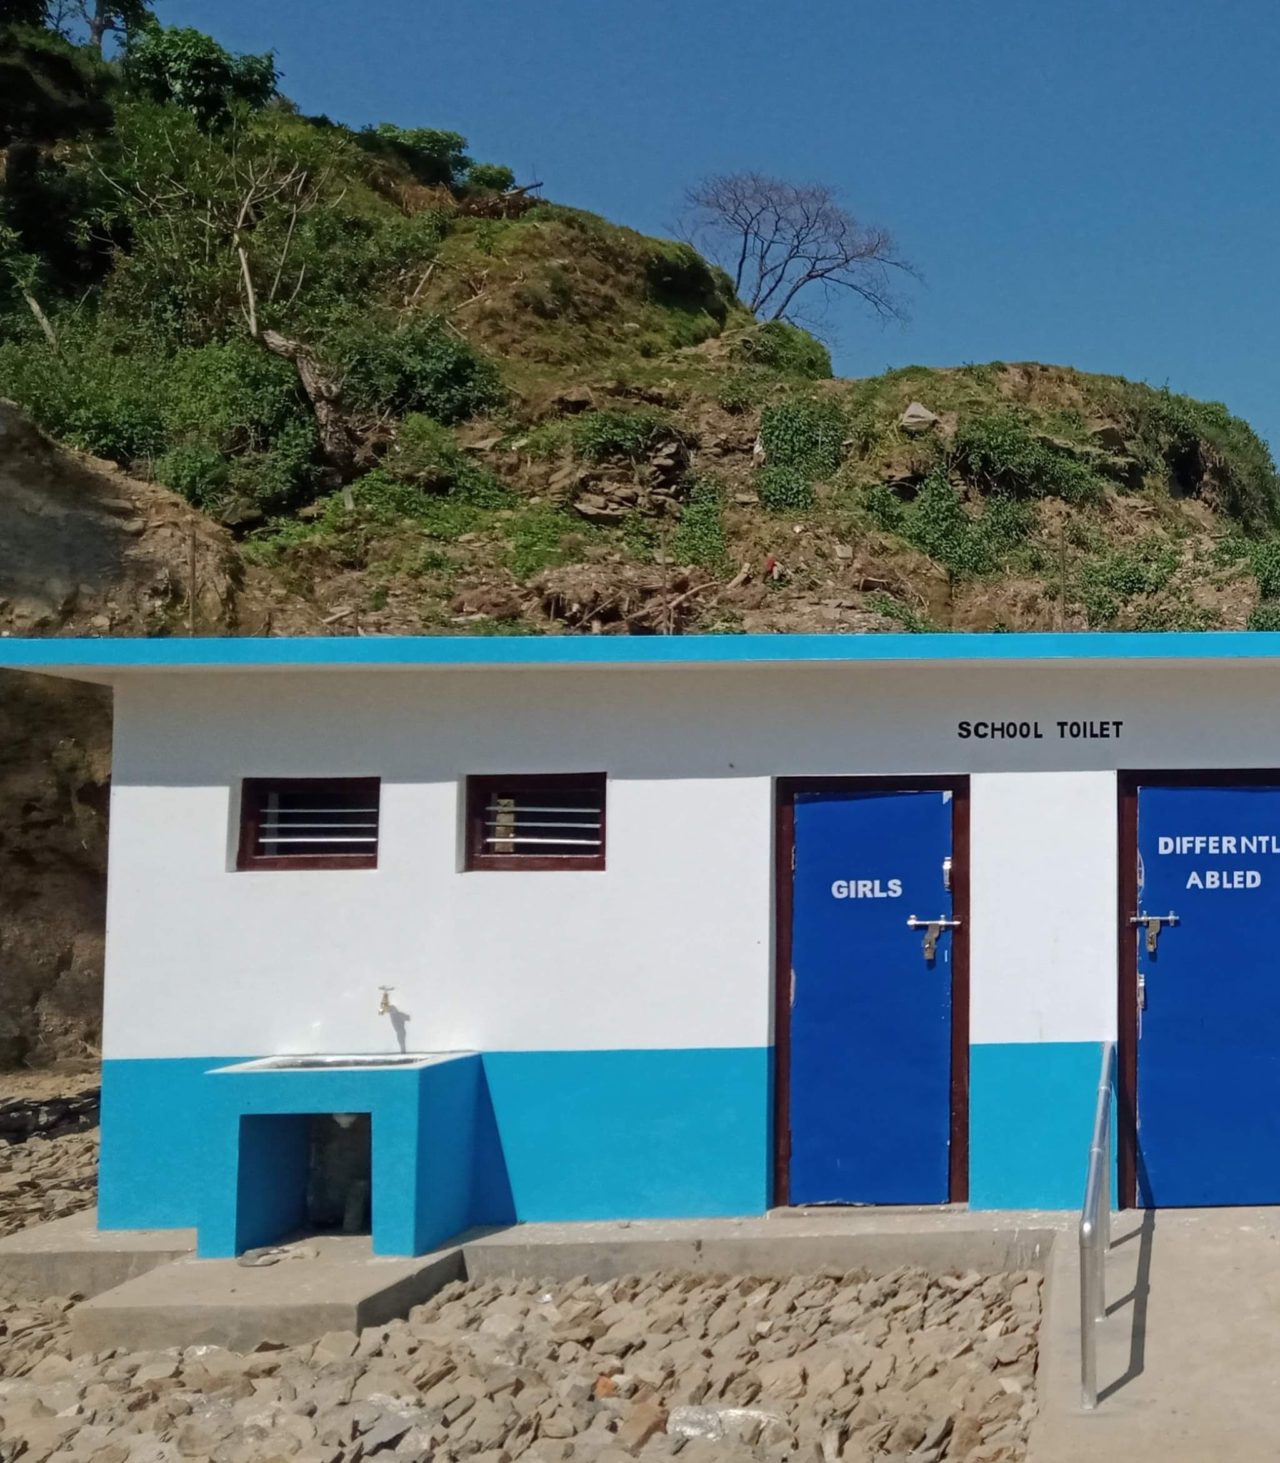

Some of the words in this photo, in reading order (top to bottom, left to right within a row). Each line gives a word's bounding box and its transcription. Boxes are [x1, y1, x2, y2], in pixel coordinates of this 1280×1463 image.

[957, 720, 1044, 739] SCHOOL
[1056, 720, 1124, 739] TOILET
[831, 878, 903, 899] GIRLS
[1186, 870, 1262, 889] ABLED
